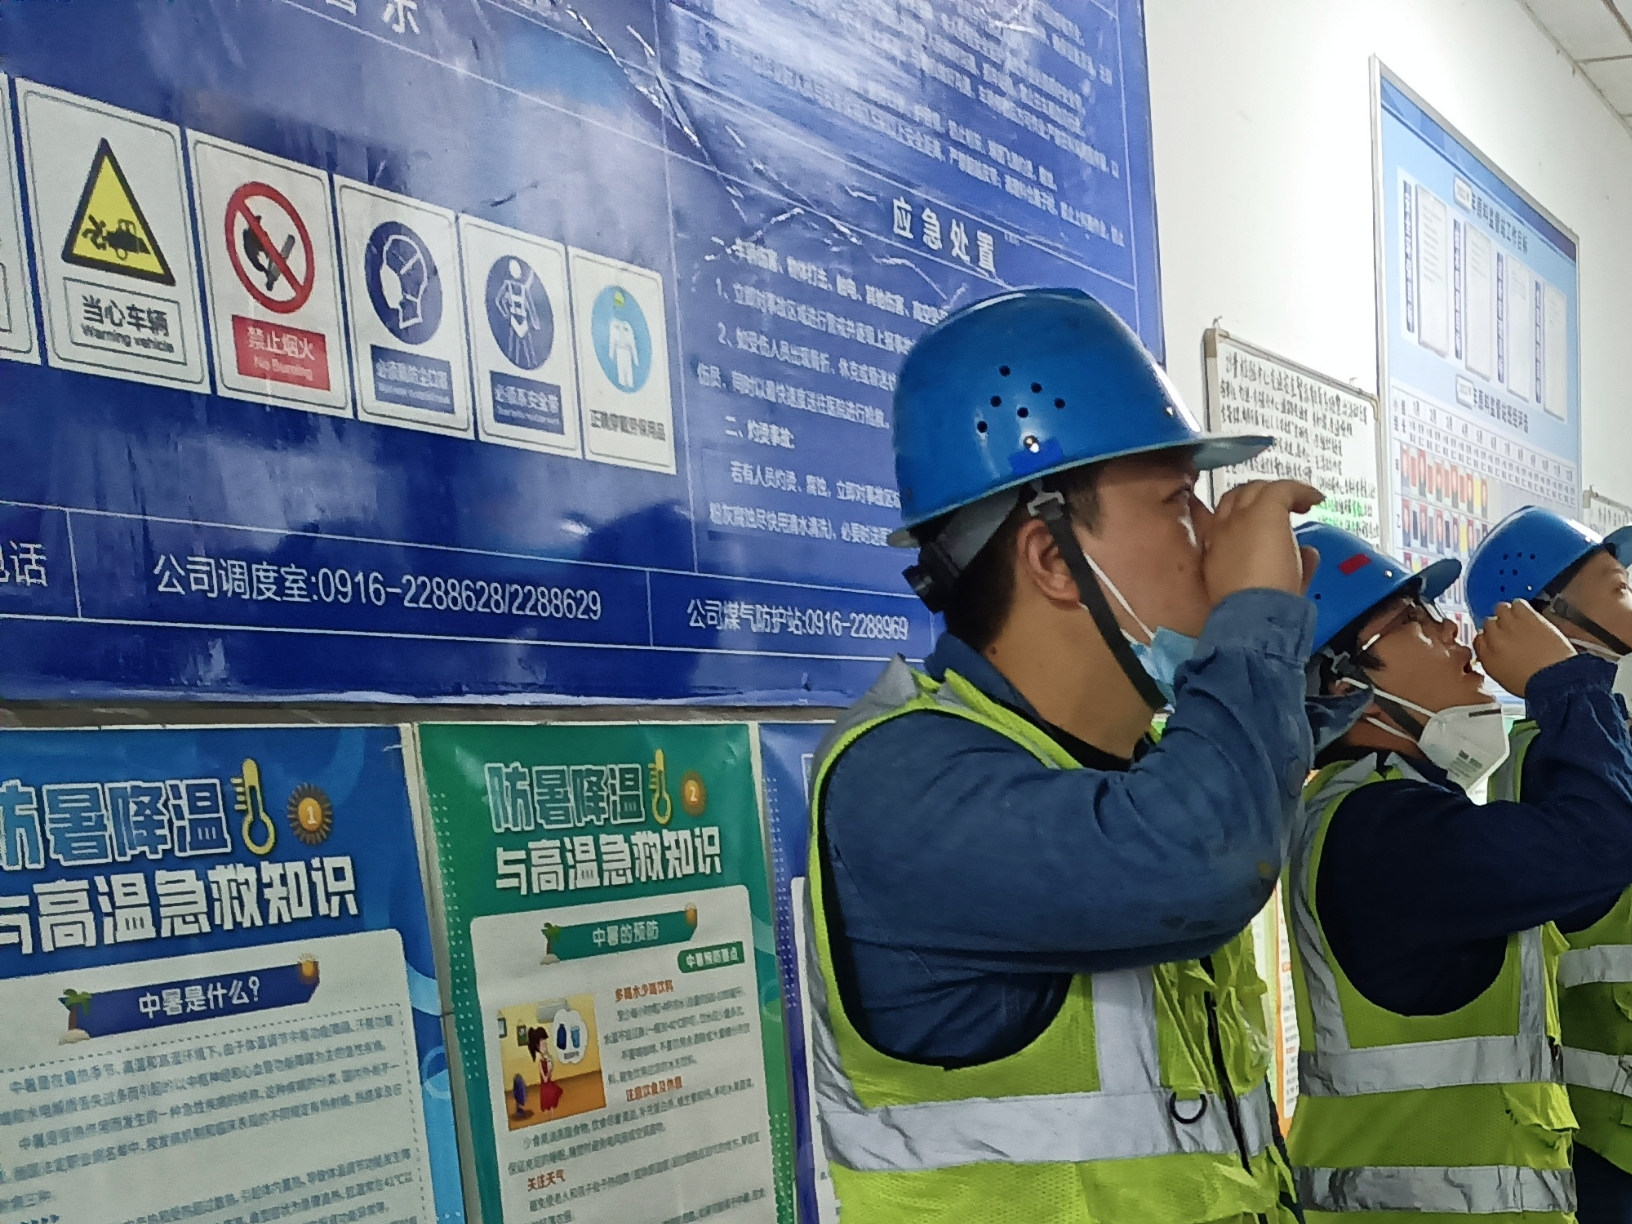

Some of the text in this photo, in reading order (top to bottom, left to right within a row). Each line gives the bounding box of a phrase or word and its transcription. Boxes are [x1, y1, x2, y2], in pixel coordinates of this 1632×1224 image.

[893, 195, 997, 275] 应急处置
[82, 295, 170, 337] 当心车辆
[81, 323, 174, 354] Warning vehicle
[247, 325, 315, 361] 禁止烟火
[254, 356, 313, 381] No Burning
[495, 384, 560, 414] 必须系安全带
[0, 538, 48, 588] 话
[152, 552, 602, 623] 公司调度室:0916-2288628/2288629
[484, 761, 646, 834] 防暑降温
[689, 786, 698, 803] 2
[495, 826, 723, 897] 与高温急救知识
[0, 855, 360, 956] 与高温急救知识
[592, 919, 660, 948] 中暑的预防
[138, 975, 261, 1020] 中暑是什么?
[528, 1168, 566, 1192] 关注天气
